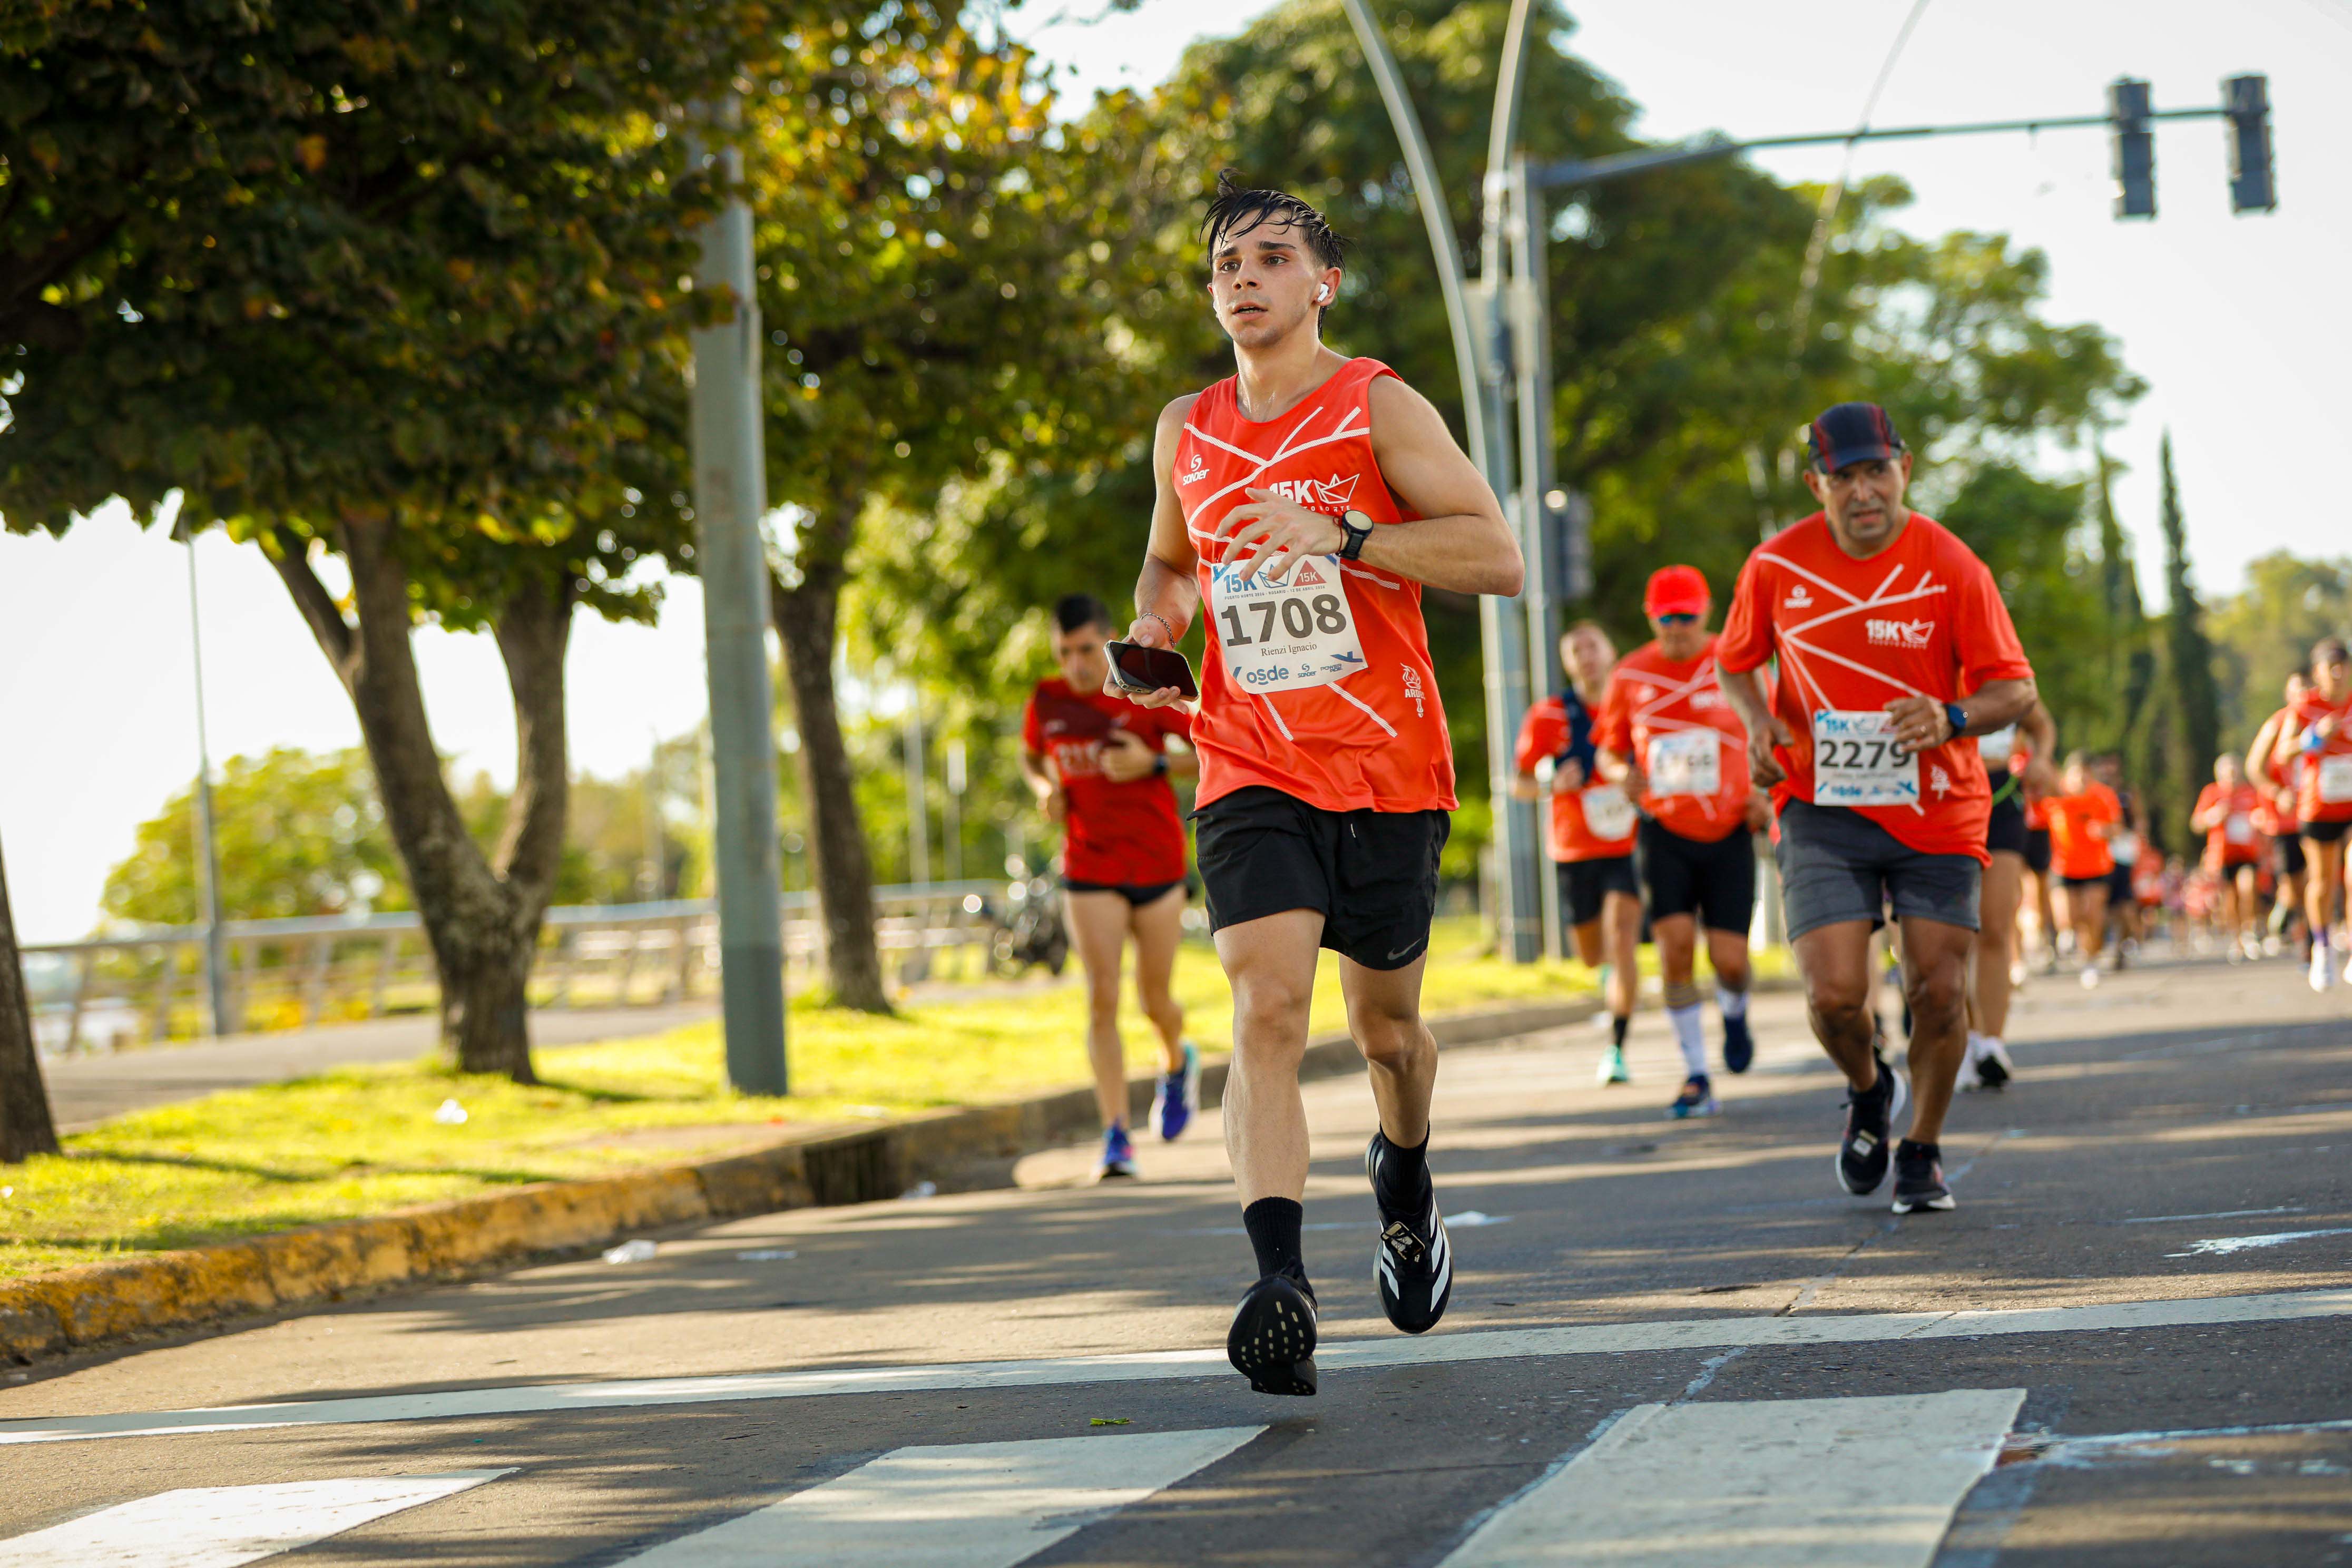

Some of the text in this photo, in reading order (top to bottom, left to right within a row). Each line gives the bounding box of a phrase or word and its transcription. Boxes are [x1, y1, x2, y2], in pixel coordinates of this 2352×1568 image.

[1299, 571, 1318, 582] 15K
[1221, 594, 1347, 646] 1708
[1865, 619, 1899, 641] 15K
[1261, 642, 1317, 656] Rienzi Ignacio
[1247, 664, 1289, 685] osde
[1826, 720, 1849, 732] 15K
[1820, 740, 1911, 769] 2279
